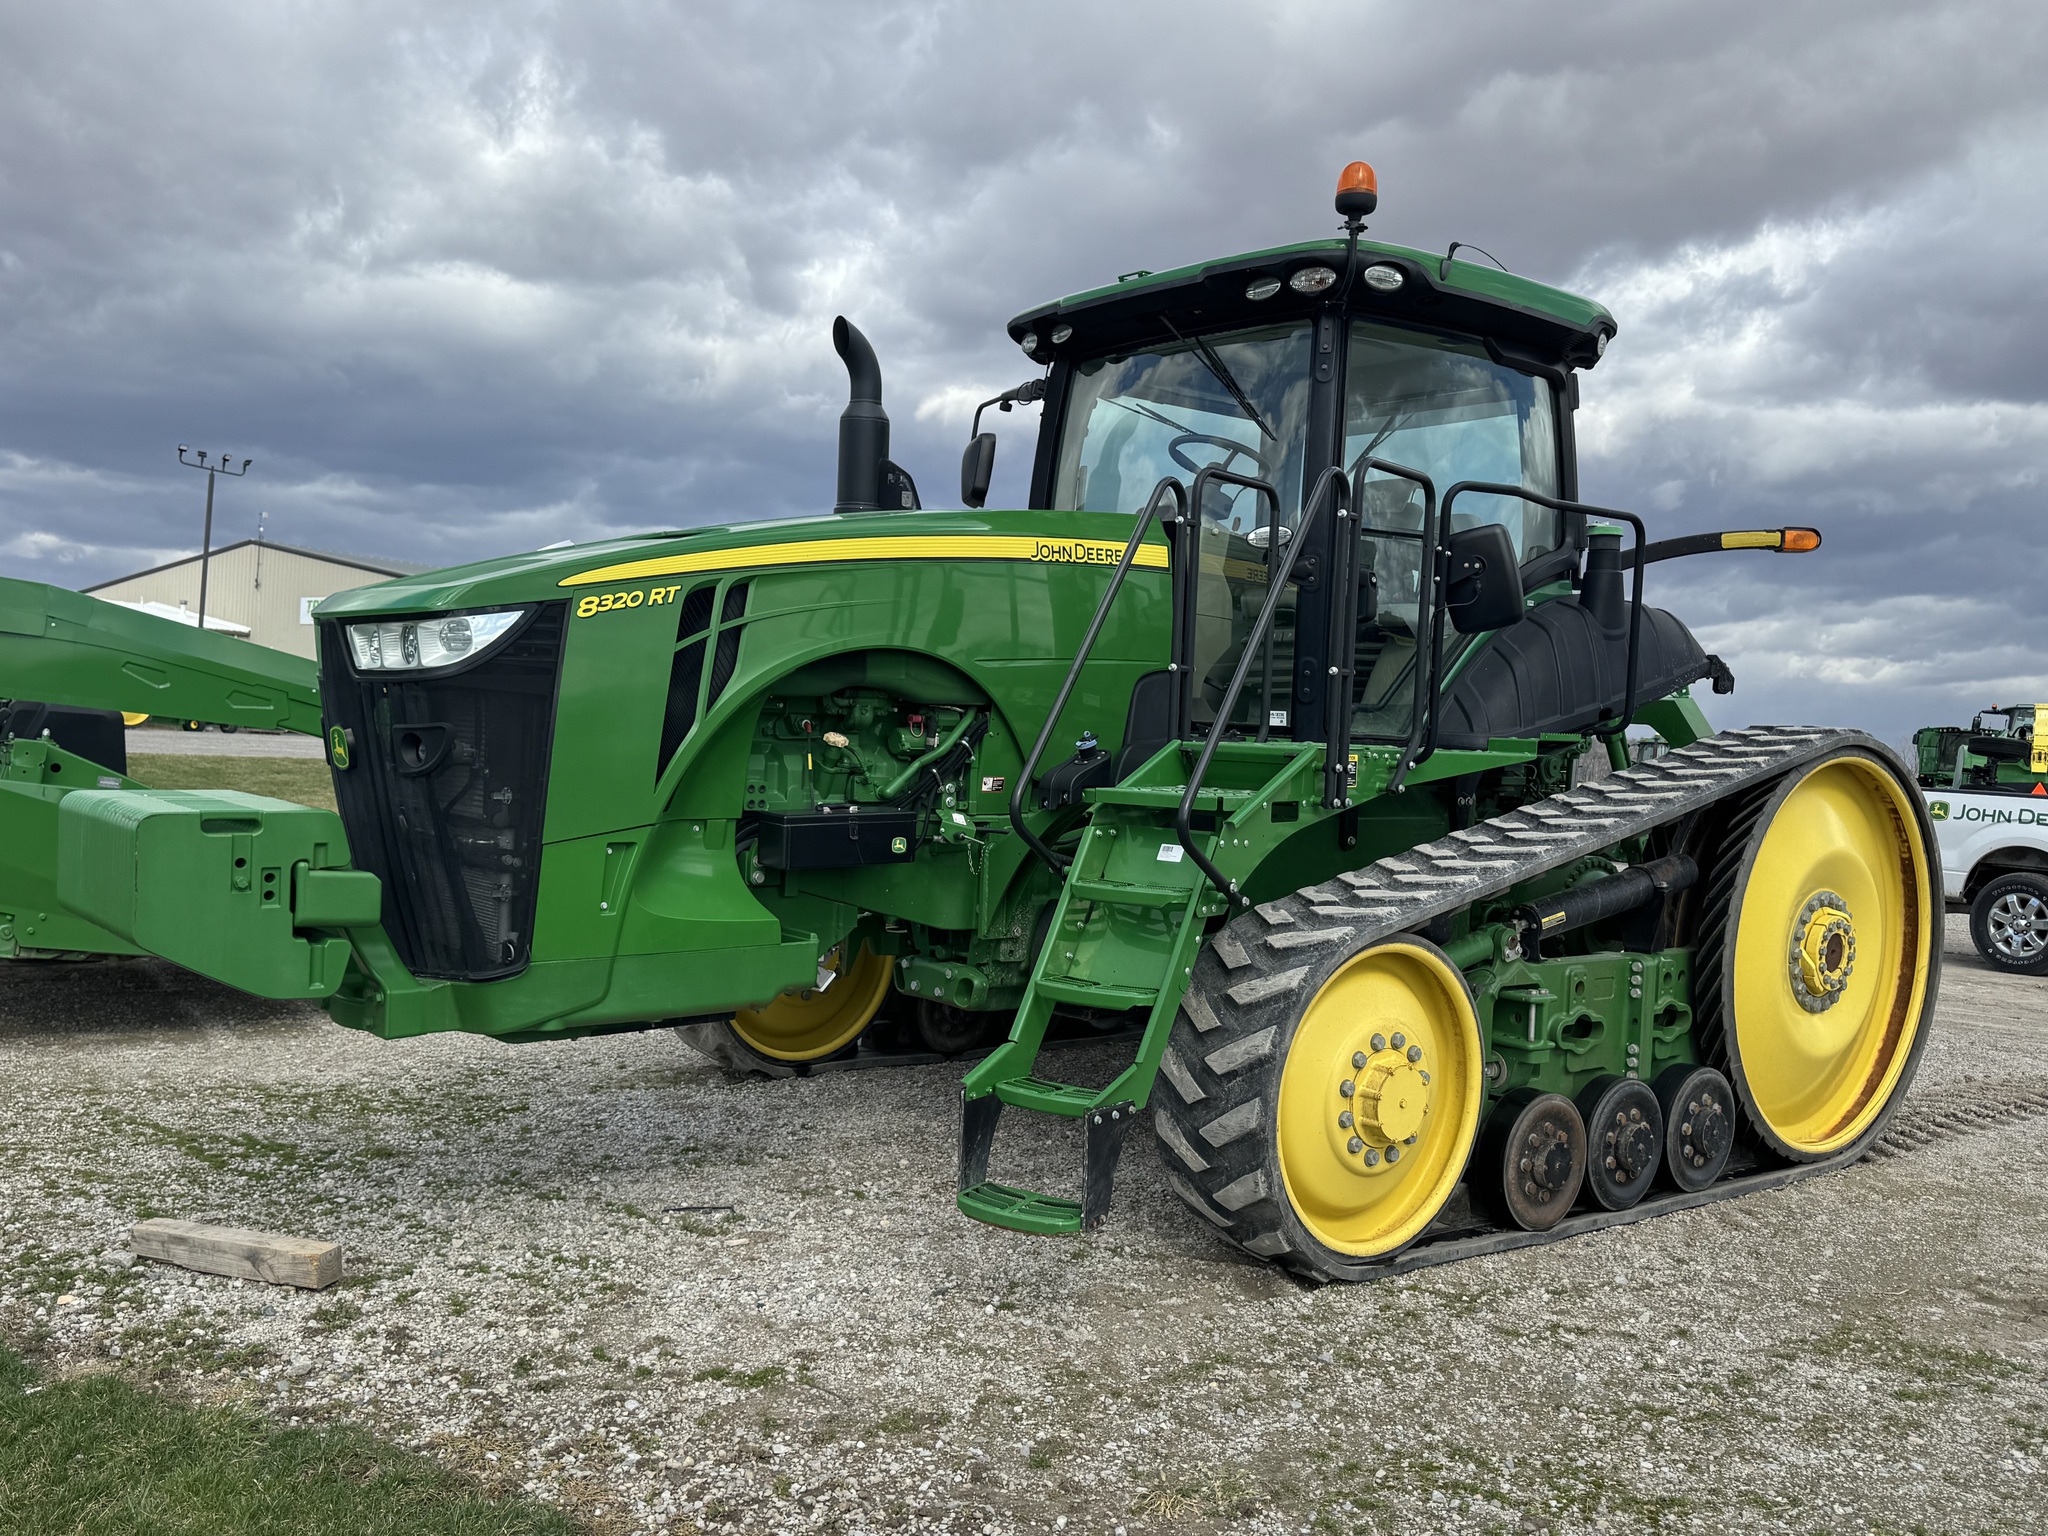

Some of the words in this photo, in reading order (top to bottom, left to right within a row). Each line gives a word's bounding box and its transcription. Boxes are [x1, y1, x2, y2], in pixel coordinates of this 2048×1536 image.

[1031, 541, 1072, 560] JOHN
[1075, 543, 1123, 563] DEERE
[577, 590, 645, 618] 8320
[648, 585, 682, 606] RT
[1953, 804, 2012, 824] JOHN
[2018, 808, 2048, 827] DE
